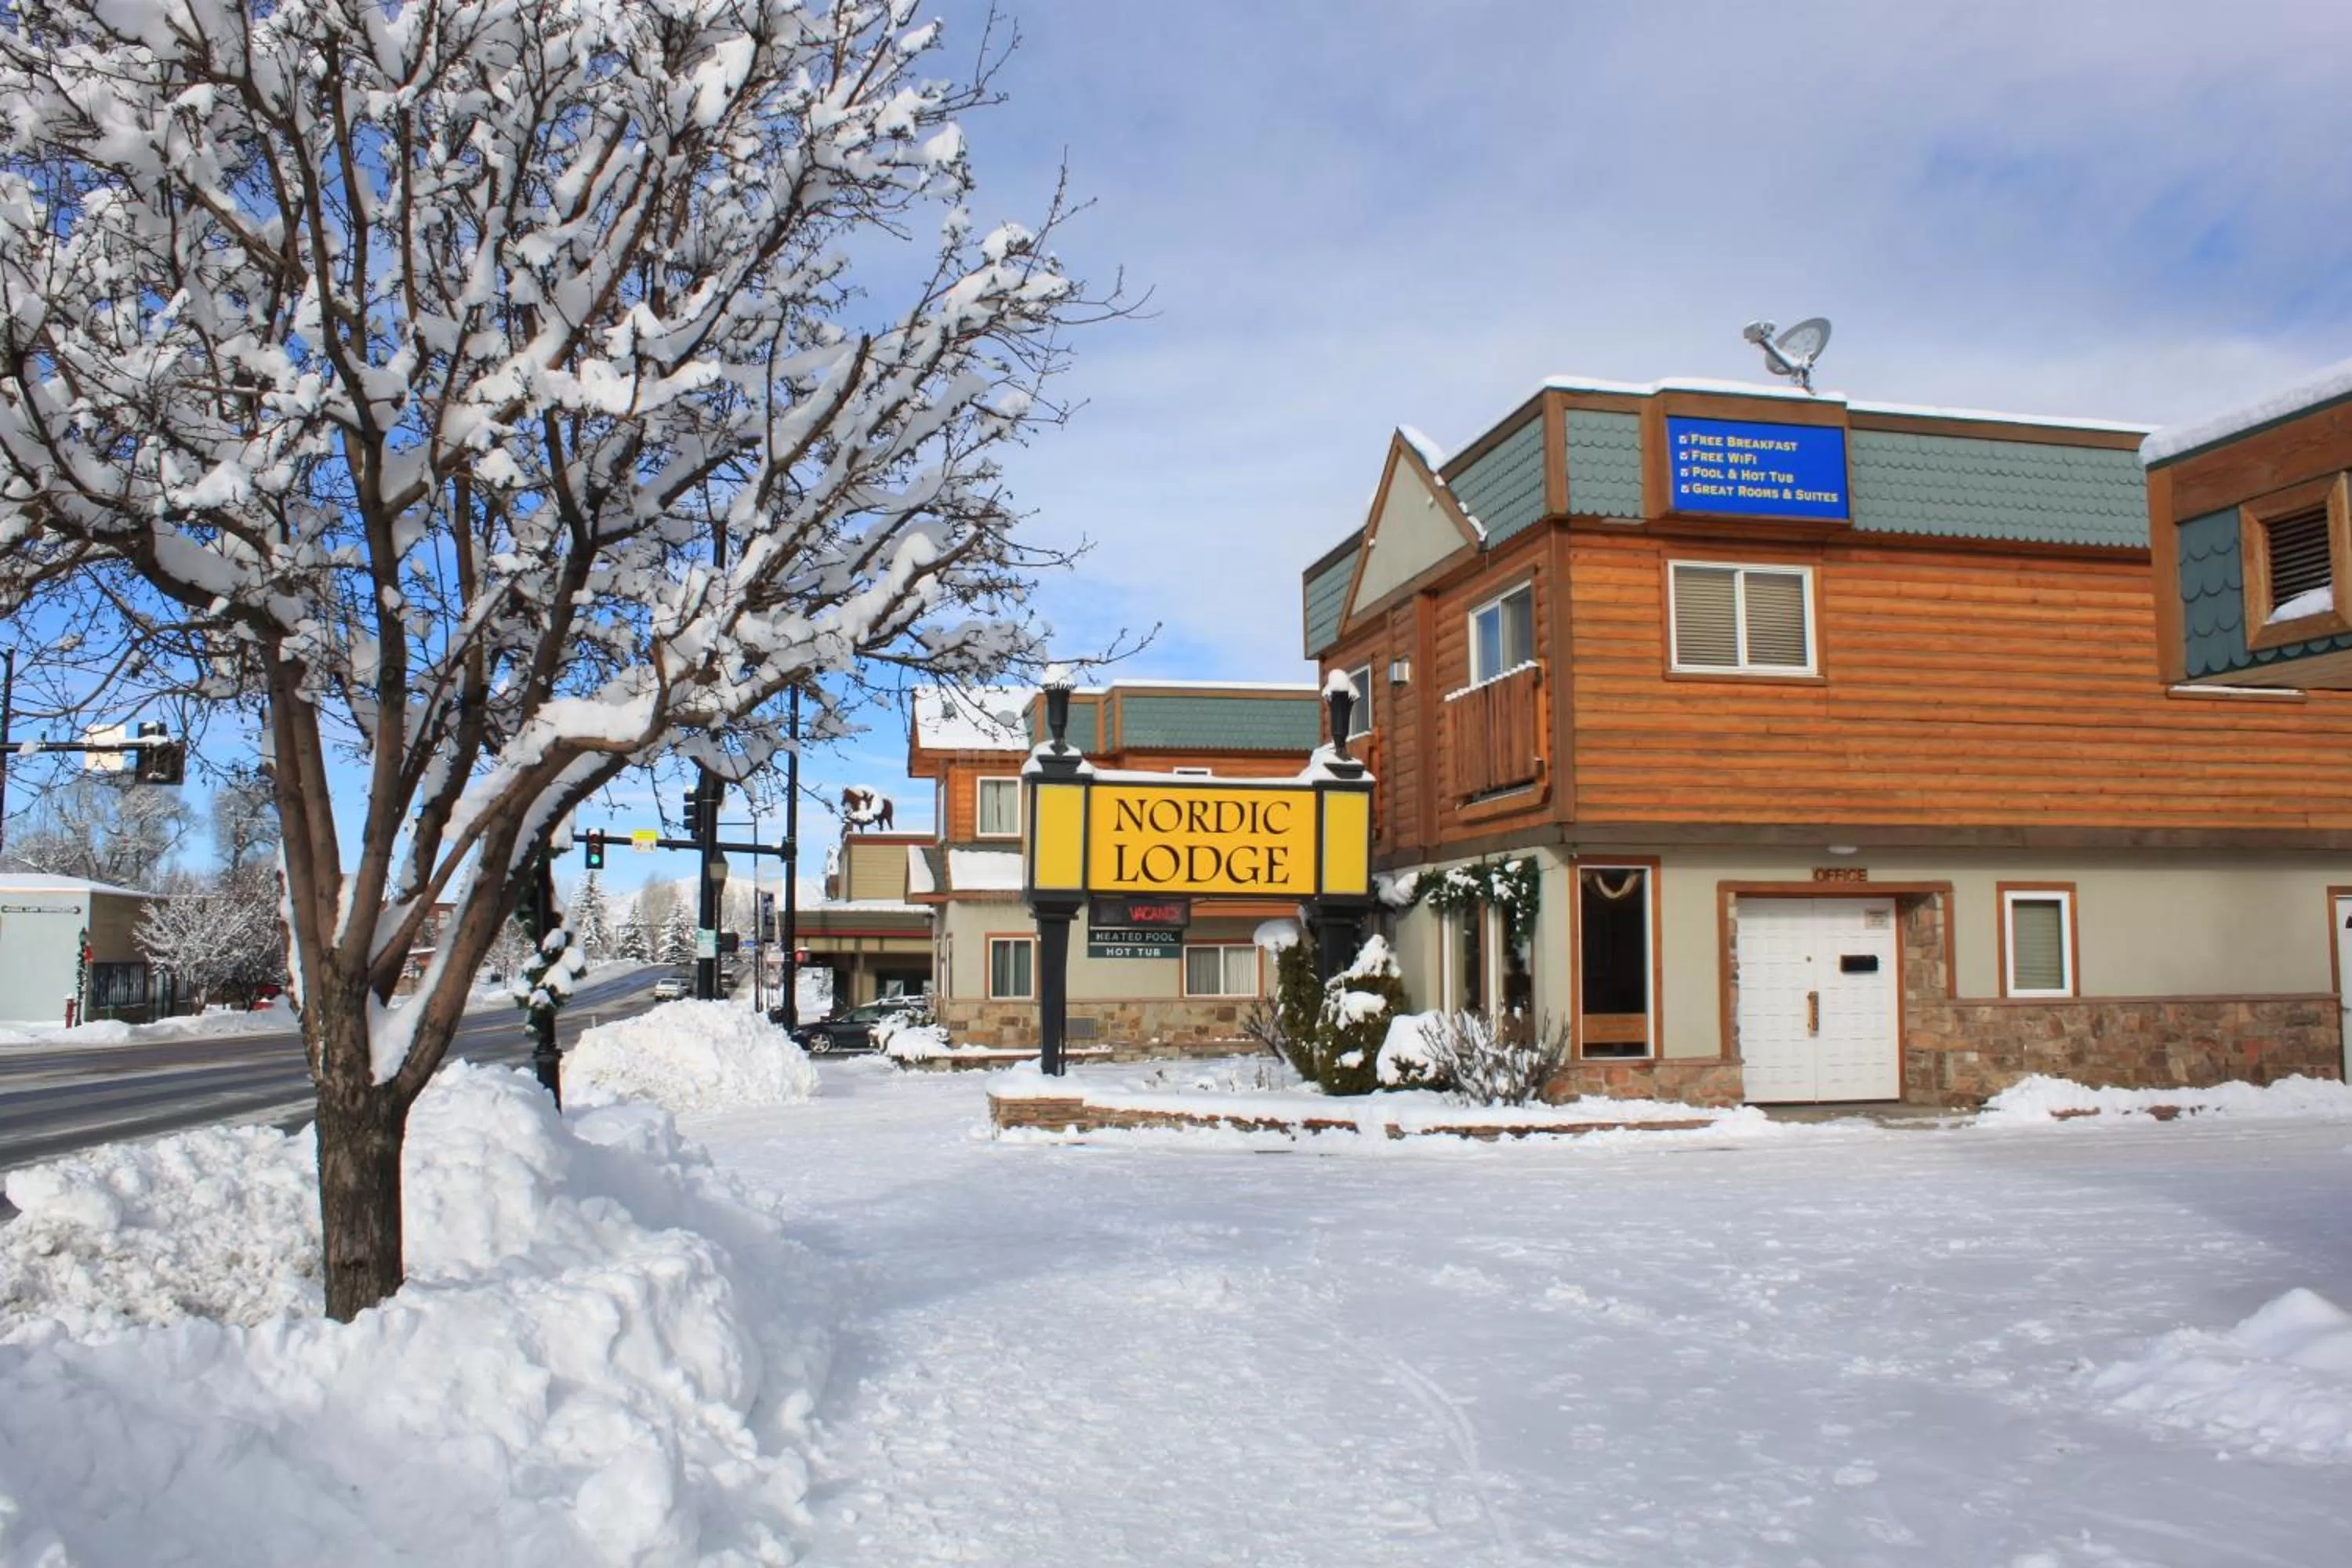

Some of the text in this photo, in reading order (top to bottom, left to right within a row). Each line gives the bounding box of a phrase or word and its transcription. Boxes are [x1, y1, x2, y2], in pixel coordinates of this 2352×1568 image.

[1727, 468, 1737, 480] &
[1782, 488, 1792, 499] &
[1113, 798, 1291, 835] NORDIC
[1113, 844, 1290, 884] LODGE
[1813, 868, 1867, 882] OFFICE
[1096, 932, 1175, 942] HEATED POOL
[1106, 946, 1161, 956] HOT TUB
